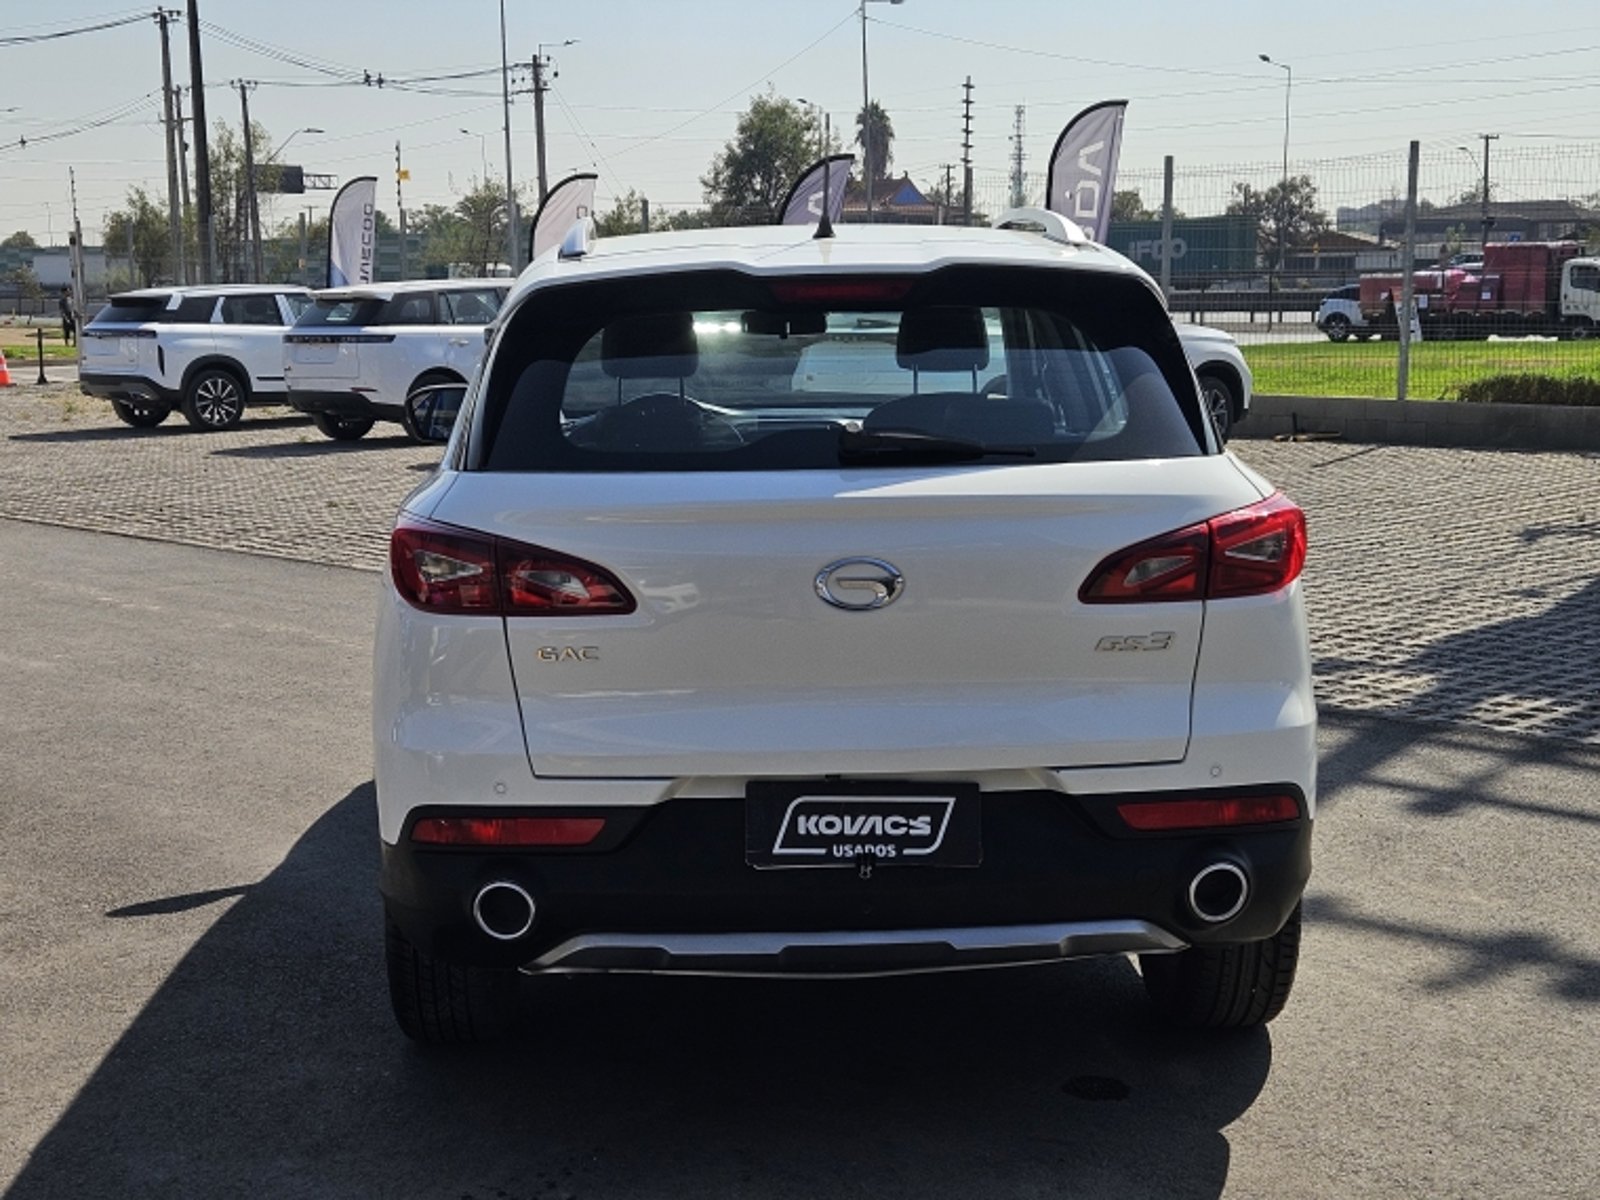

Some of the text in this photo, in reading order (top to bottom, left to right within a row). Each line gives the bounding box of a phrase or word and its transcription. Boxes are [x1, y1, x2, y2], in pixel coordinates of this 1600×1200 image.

[359, 203, 374, 285] JAECOO
[1094, 630, 1176, 652] GS3
[536, 645, 600, 662] GAC
[797, 815, 932, 836] KOVACS
[832, 844, 897, 858] USADOS
